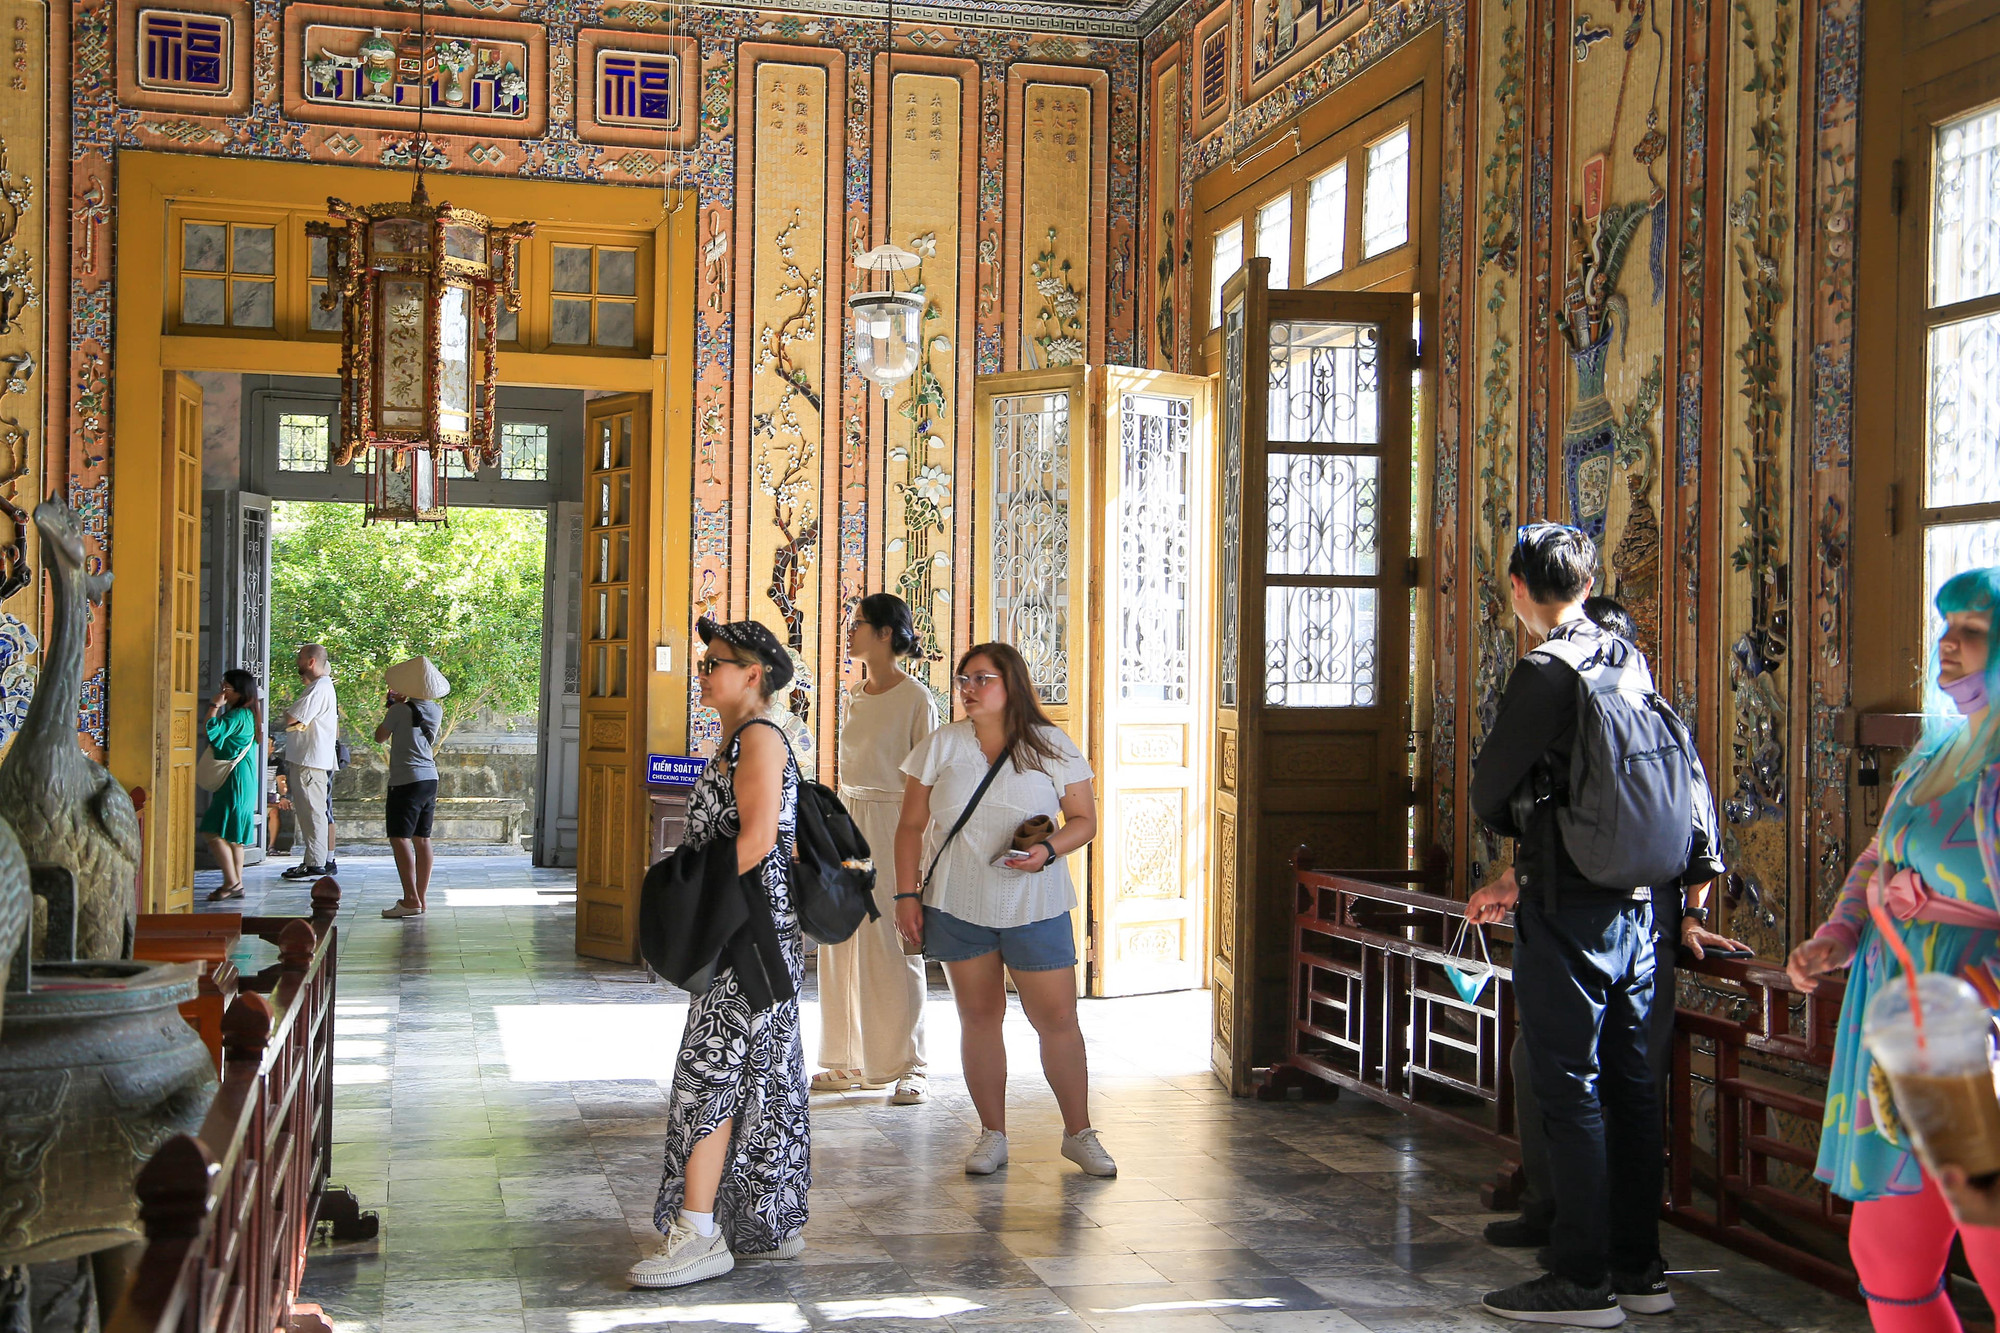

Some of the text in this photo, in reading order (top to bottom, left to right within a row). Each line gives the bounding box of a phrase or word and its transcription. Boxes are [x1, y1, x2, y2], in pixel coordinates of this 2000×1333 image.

[653, 759, 703, 775] KIỂM SOÁT VÉ
[652, 773, 679, 781] CHECKING
